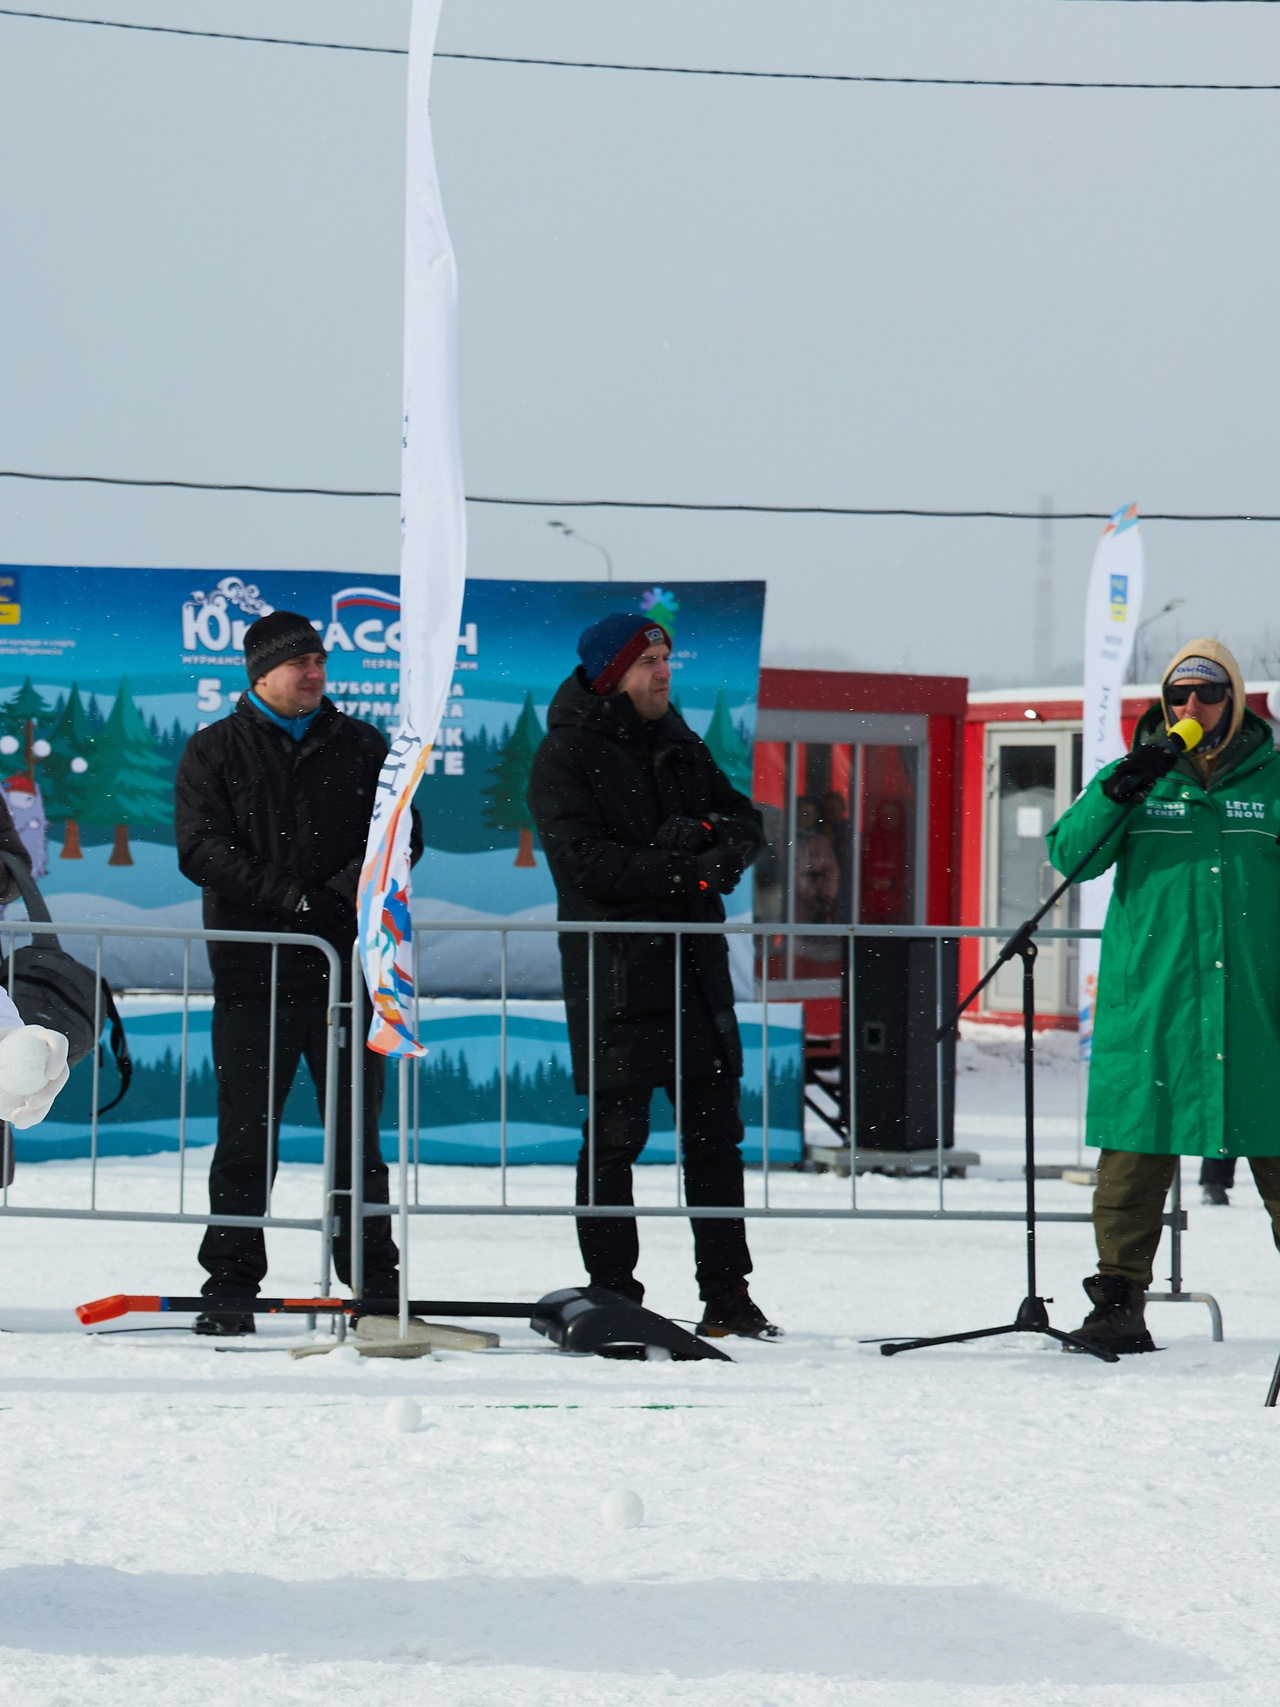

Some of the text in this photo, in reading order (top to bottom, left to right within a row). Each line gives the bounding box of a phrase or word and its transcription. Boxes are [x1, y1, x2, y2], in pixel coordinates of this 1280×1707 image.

[181, 654, 245, 667] МУРМАНС
[196, 677, 222, 713] 5
[324, 680, 387, 696] КУБОК
[1226, 800, 1265, 811] LET IT
[1226, 809, 1265, 819] SNOW
